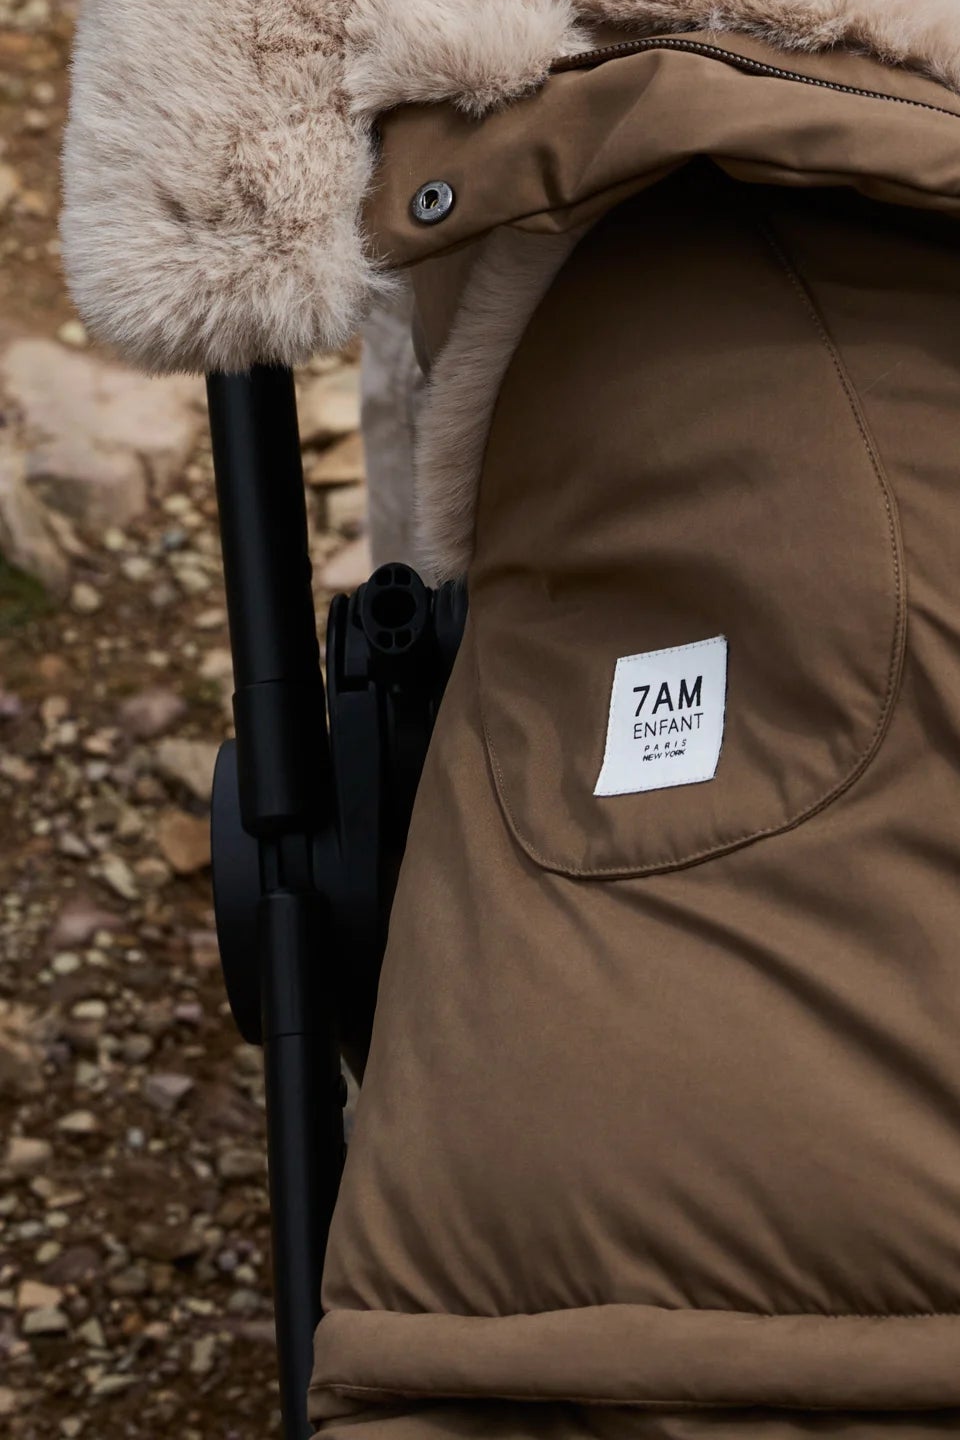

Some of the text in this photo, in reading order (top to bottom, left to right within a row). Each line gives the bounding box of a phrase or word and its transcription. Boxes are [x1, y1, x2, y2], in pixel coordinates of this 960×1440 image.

[633, 675, 702, 717] 7AM
[633, 712, 704, 740] ENFANT
[642, 749, 686, 762] NEW YORK
[645, 739, 687, 752] PARIS
